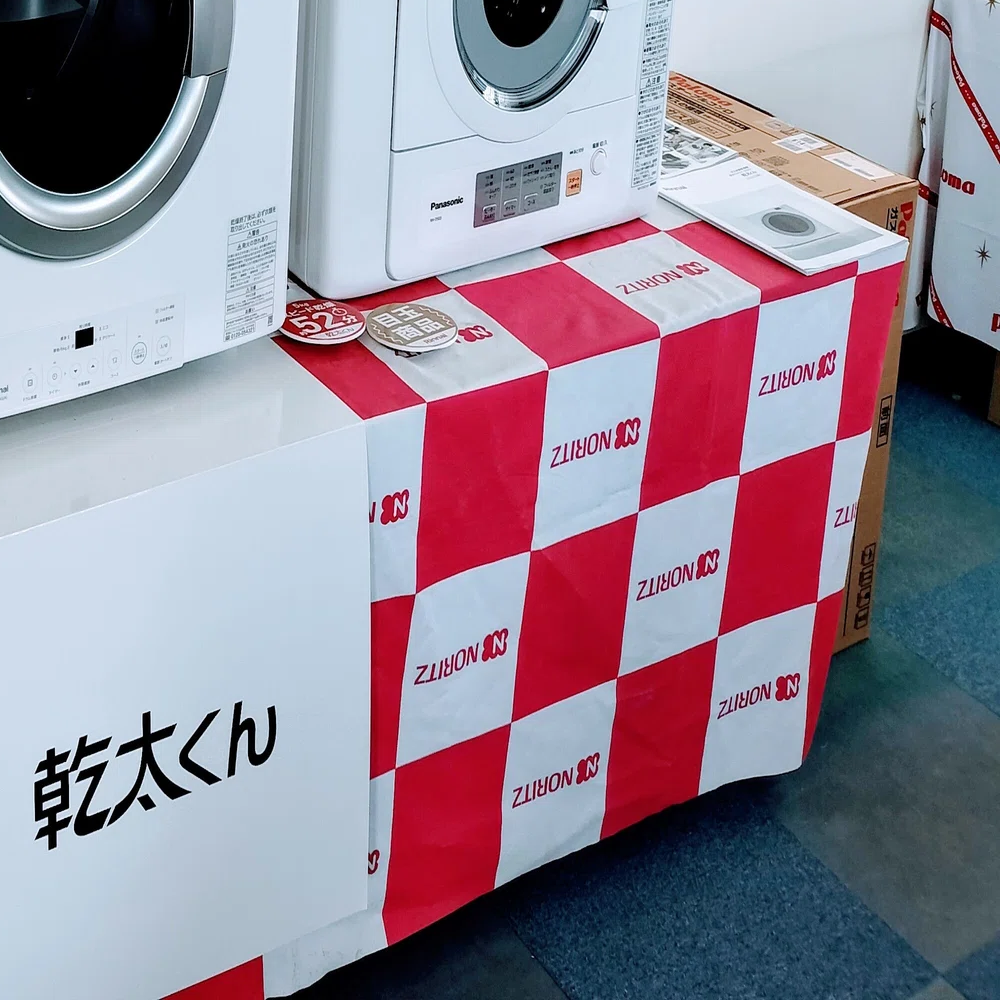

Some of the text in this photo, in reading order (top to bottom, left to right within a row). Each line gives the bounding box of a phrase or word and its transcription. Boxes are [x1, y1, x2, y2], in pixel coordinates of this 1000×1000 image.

[941, 169, 976, 196] oma
[430, 195, 464, 211] Panasonic
[616, 268, 682, 295] NORITZ
[286, 301, 336, 318] ピード乾燥
[758, 360, 816, 396] NORITZ
[551, 428, 612, 469] NORITZ
[834, 502, 858, 528] ITZ
[636, 563, 695, 601] NORITZ
[413, 641, 479, 686] NORITZ
[717, 681, 772, 720] NORITZ
[33, 700, 278, 850] 乾太くん
[512, 769, 573, 809] NORITZ
